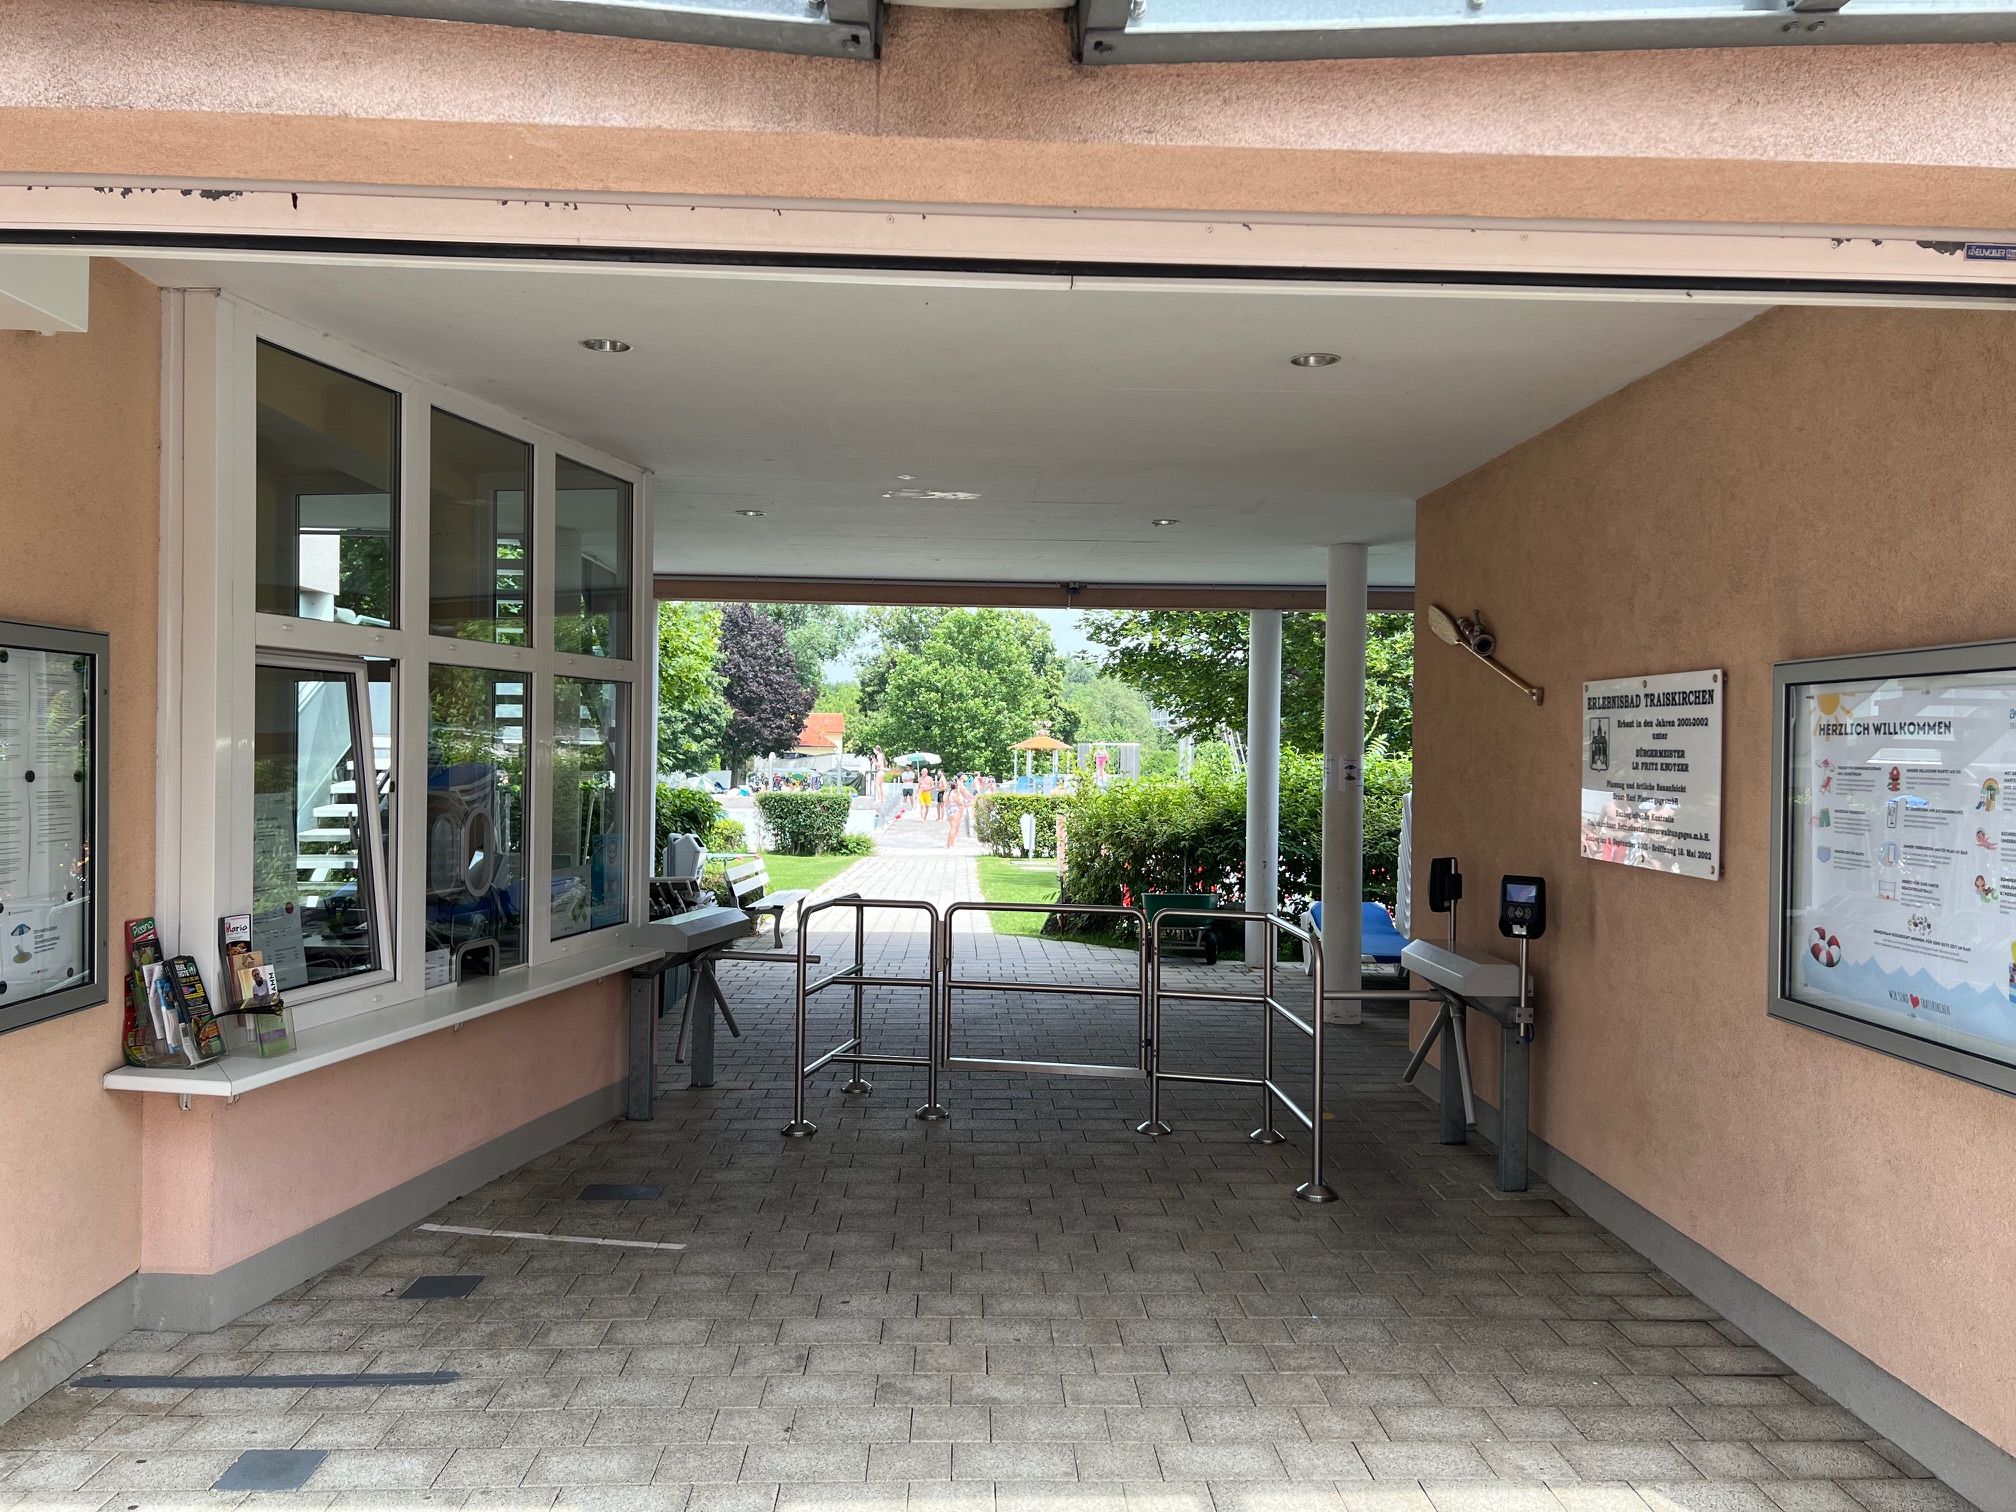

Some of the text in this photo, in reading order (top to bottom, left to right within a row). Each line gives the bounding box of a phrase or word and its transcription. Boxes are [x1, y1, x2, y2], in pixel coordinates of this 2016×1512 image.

[1587, 689, 1715, 710] ERLEBNISBAD TRAISKIRCHEN
[1617, 717, 1709, 728] Erbaut in den Jahren 2001-2002
[1819, 721, 1952, 736] HERZLICH WILLKOMMEN
[1652, 732, 1668, 740] unter
[1635, 747, 1686, 759] BÜRGERMEISTER
[1641, 762, 1659, 771] FRITZ
[1660, 762, 1690, 772] KNOTZER
[1607, 780, 1687, 793] Planung und örtliche Bauaufsicht
[1651, 843, 1676, 856] Eröffnung
[1686, 848, 1697, 859] Mai
[1697, 851, 1712, 861] 2002
